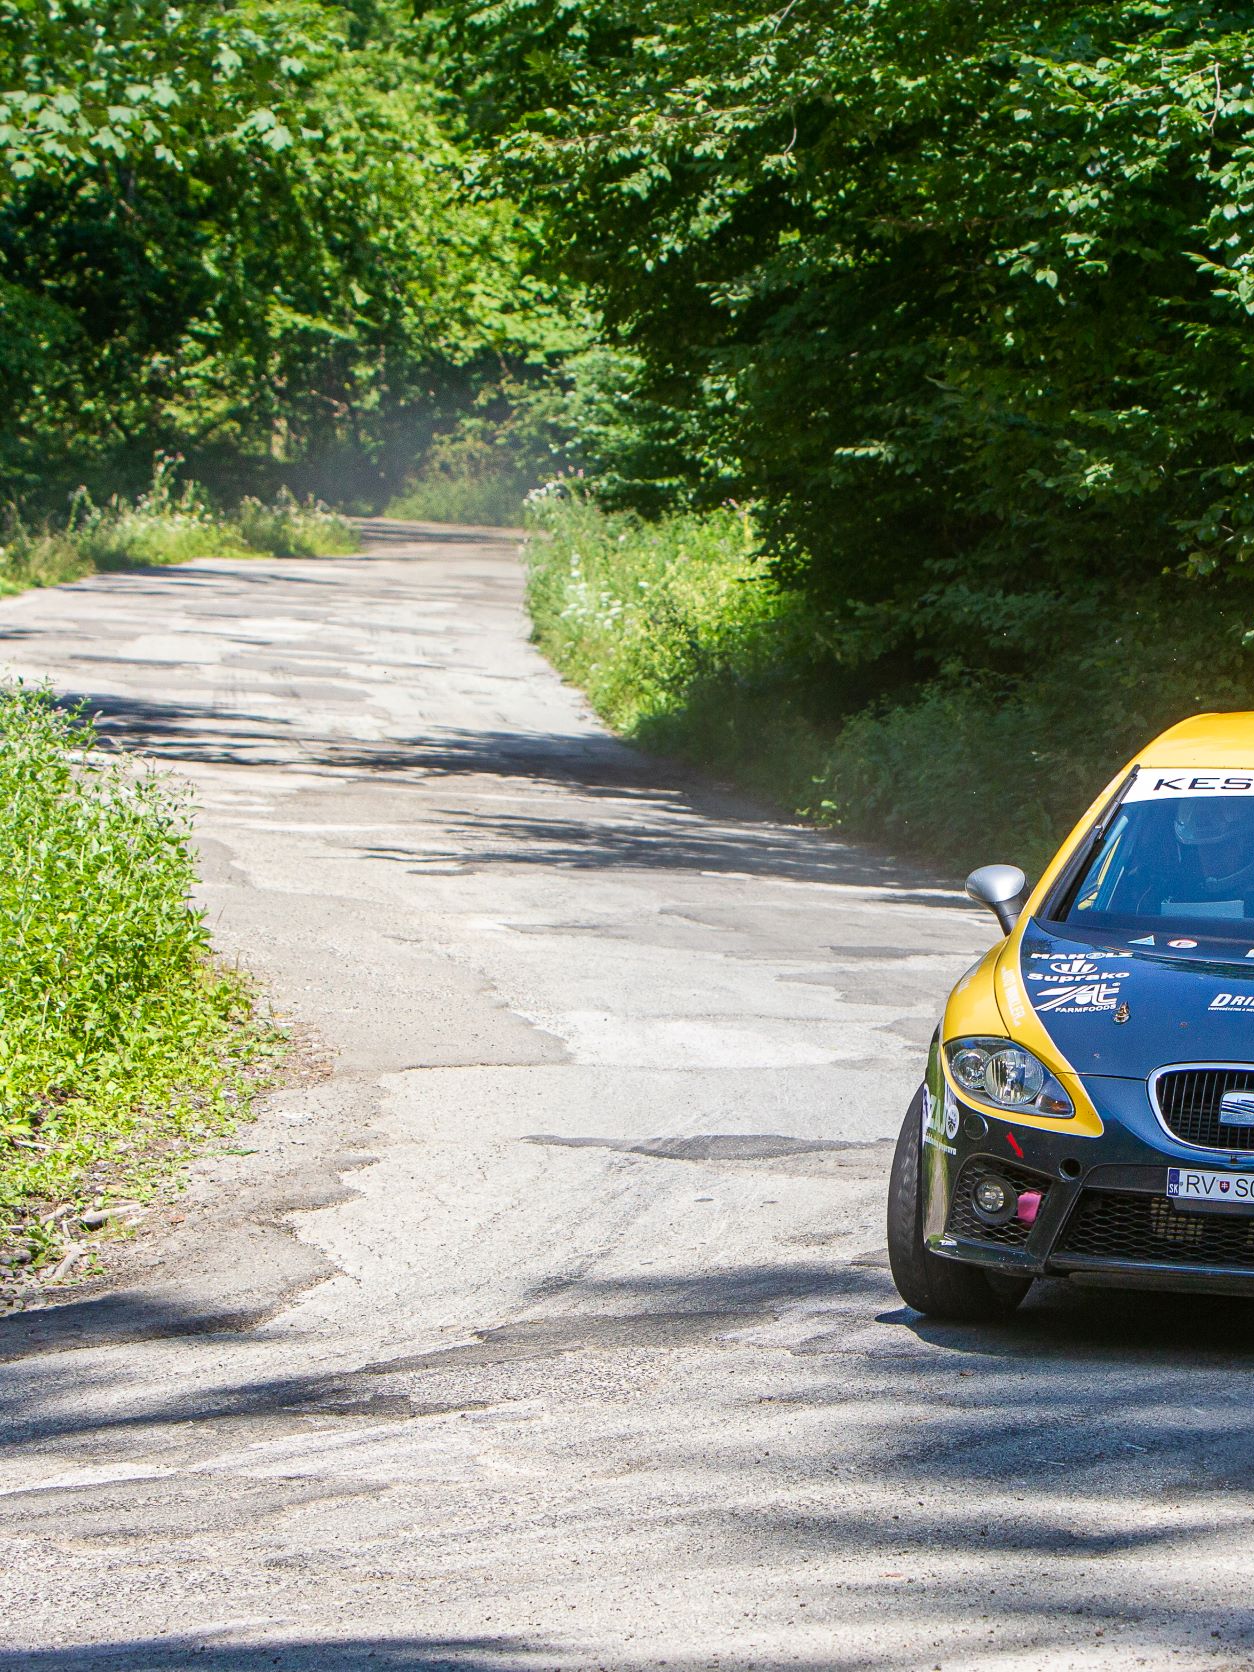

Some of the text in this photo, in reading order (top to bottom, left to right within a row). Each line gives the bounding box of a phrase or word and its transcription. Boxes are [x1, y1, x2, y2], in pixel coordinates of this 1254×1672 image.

[1030, 952, 1134, 960] MAHOLZ
[1027, 972, 1130, 983] Suprako
[1055, 1003, 1117, 1013] FARMFOODS
[1168, 1183, 1179, 1194] SK
[1186, 1174, 1216, 1195] RV
